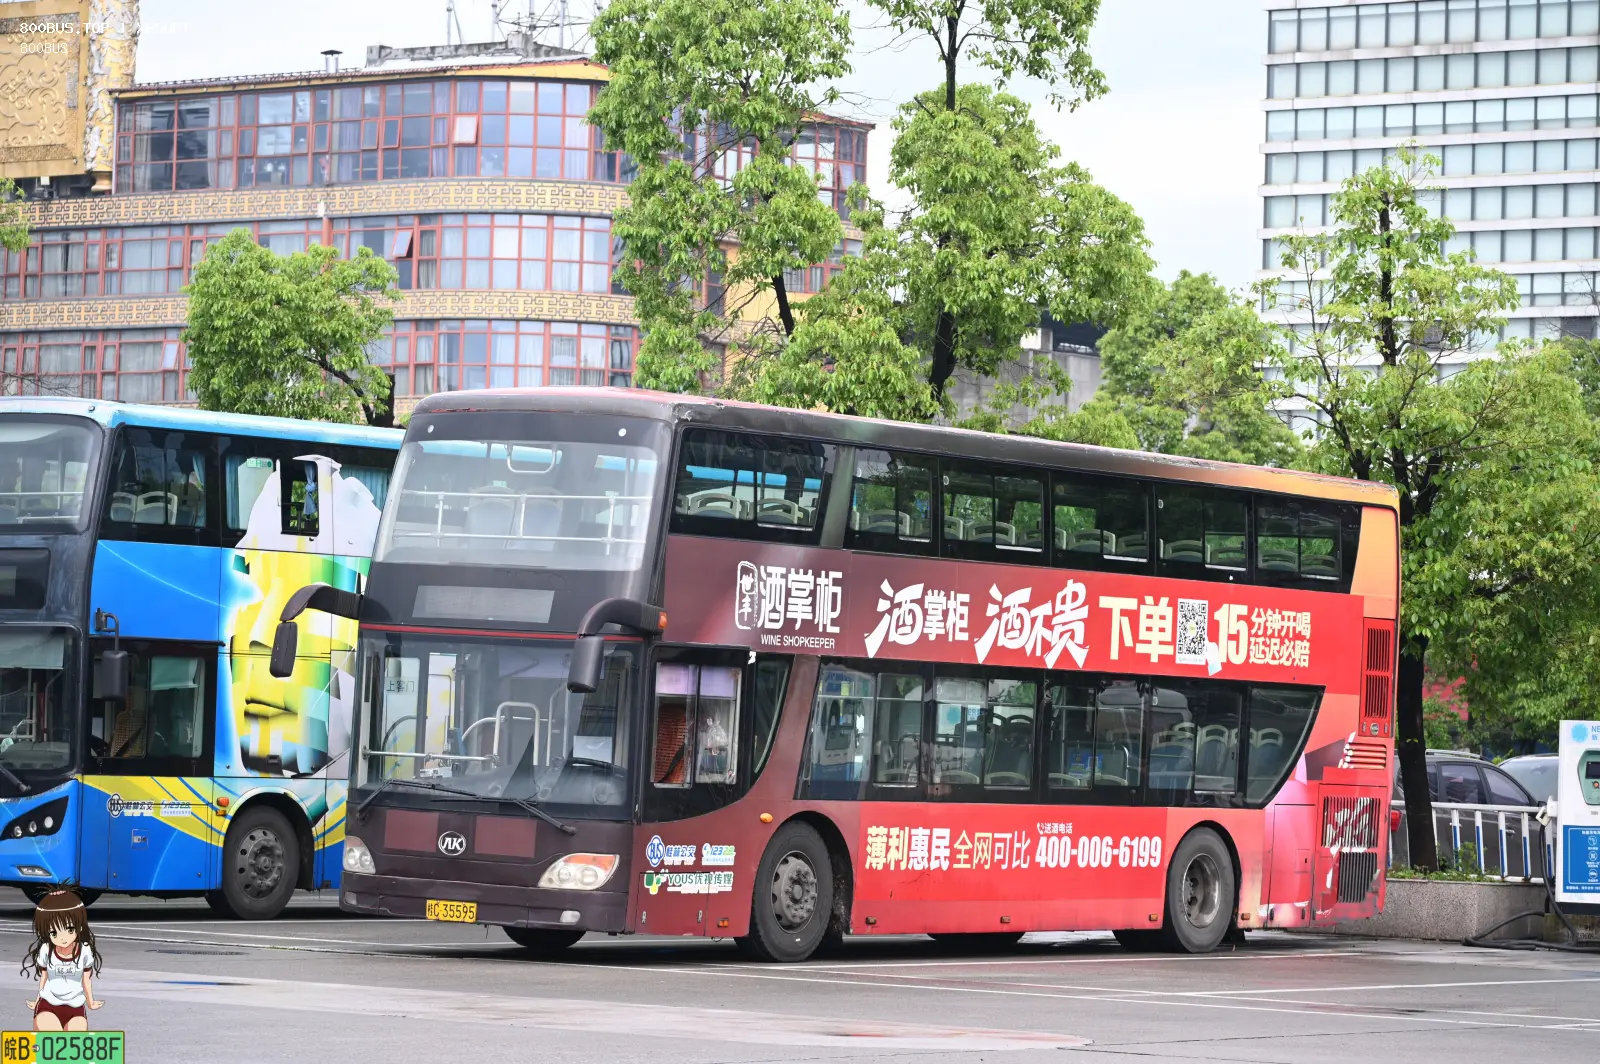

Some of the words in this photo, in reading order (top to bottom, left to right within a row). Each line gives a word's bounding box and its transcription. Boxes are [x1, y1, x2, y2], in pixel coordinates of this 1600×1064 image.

[757, 565, 843, 634] 酒掌柜
[761, 634, 782, 646] WINE
[783, 635, 836, 649] SHOPKEEPER
[863, 578, 971, 659] 酒掌柜
[974, 579, 1090, 670] 酒不贵
[1098, 595, 1175, 664] 下单
[1213, 603, 1249, 665] 15
[1250, 608, 1312, 640] 分钟开喝
[1248, 636, 1311, 669] 延迟必赔
[864, 826, 951, 871] 薄利惠民
[953, 829, 1031, 870] 全网可比
[1034, 835, 1162, 869] 400-006-6199
[1044, 822, 1073, 835] 送酒电话
